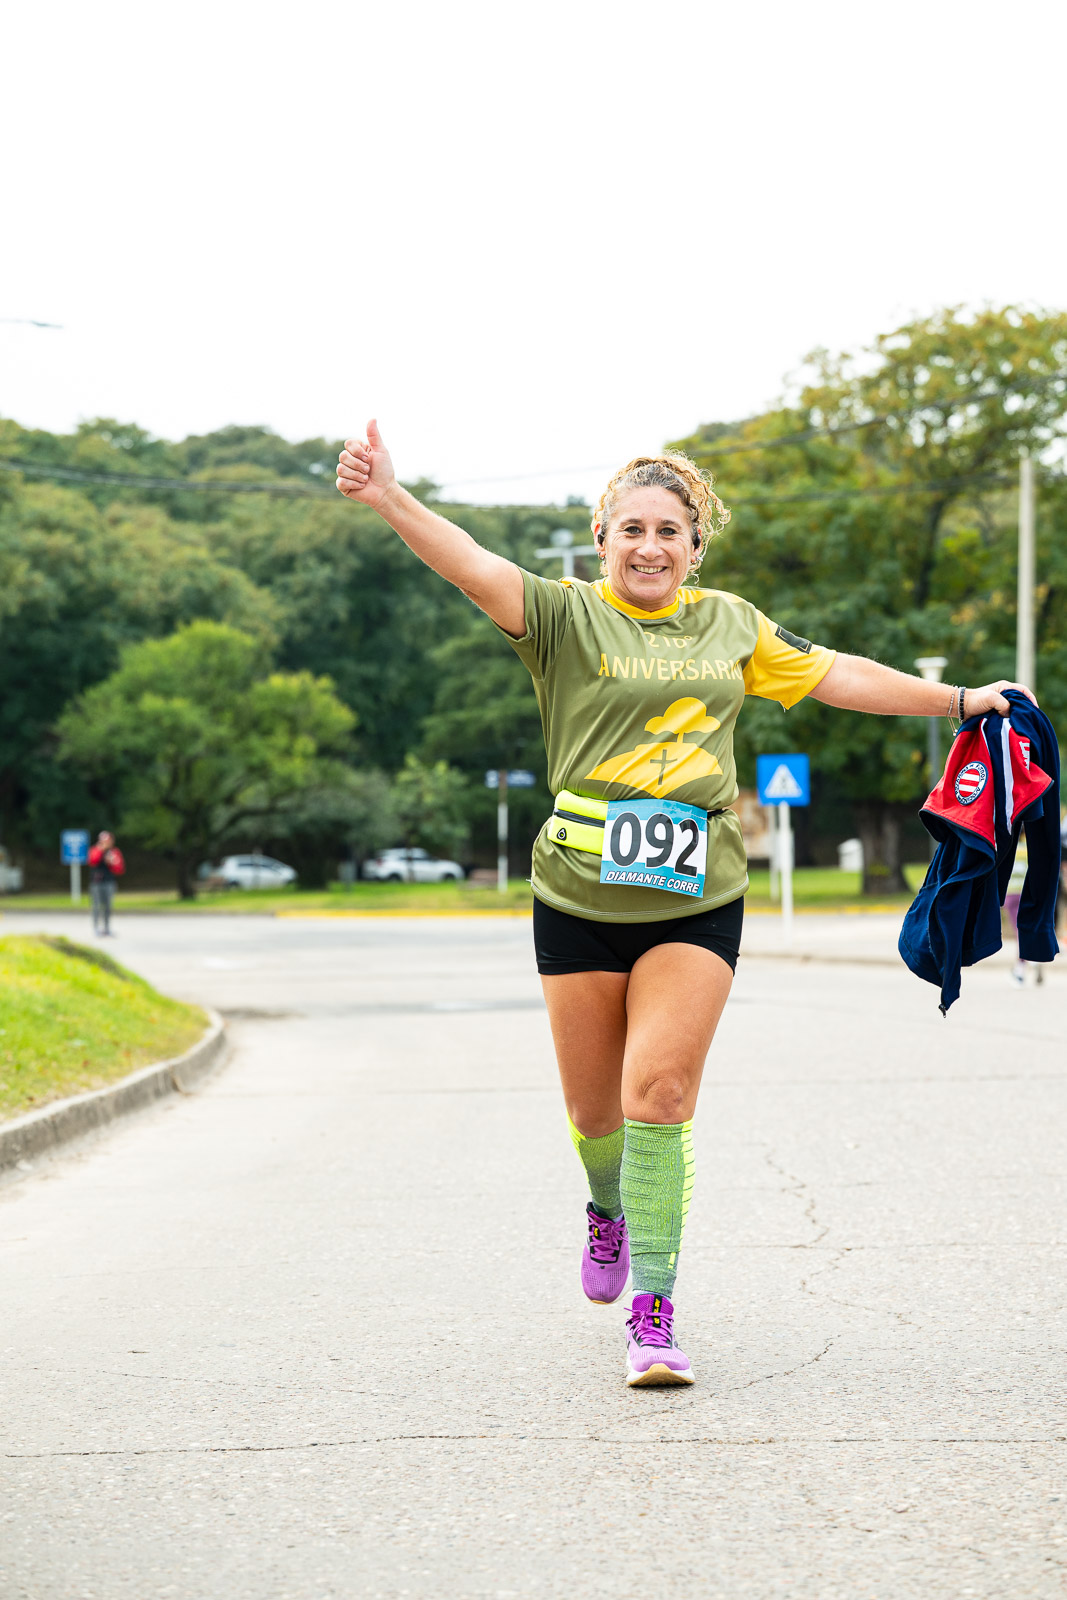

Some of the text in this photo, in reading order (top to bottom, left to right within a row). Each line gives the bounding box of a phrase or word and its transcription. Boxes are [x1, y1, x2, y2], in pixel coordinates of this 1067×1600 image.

[610, 812, 699, 878] 092
[605, 871, 700, 894] DIAMANTE CORRE
